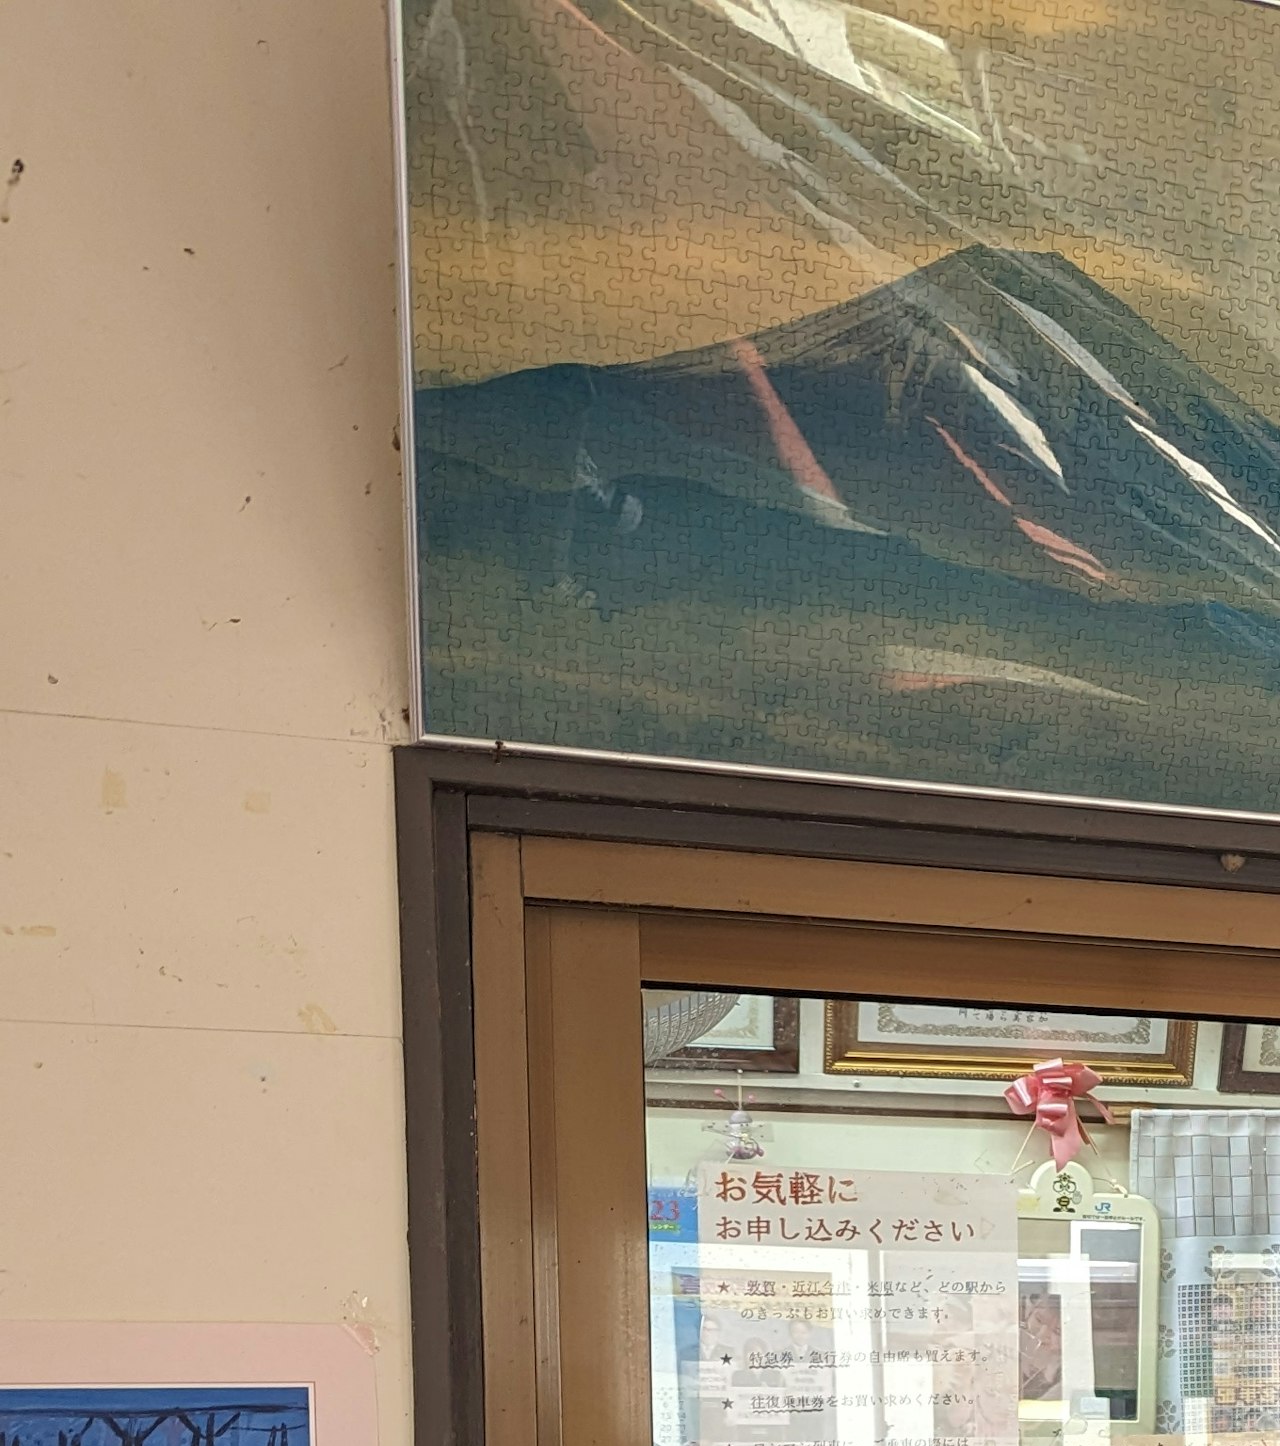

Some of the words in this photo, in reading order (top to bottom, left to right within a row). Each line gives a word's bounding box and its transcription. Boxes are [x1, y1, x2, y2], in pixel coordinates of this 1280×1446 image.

[715, 1171, 858, 1206] お気軽に
[714, 1216, 976, 1243] お申し込みください
